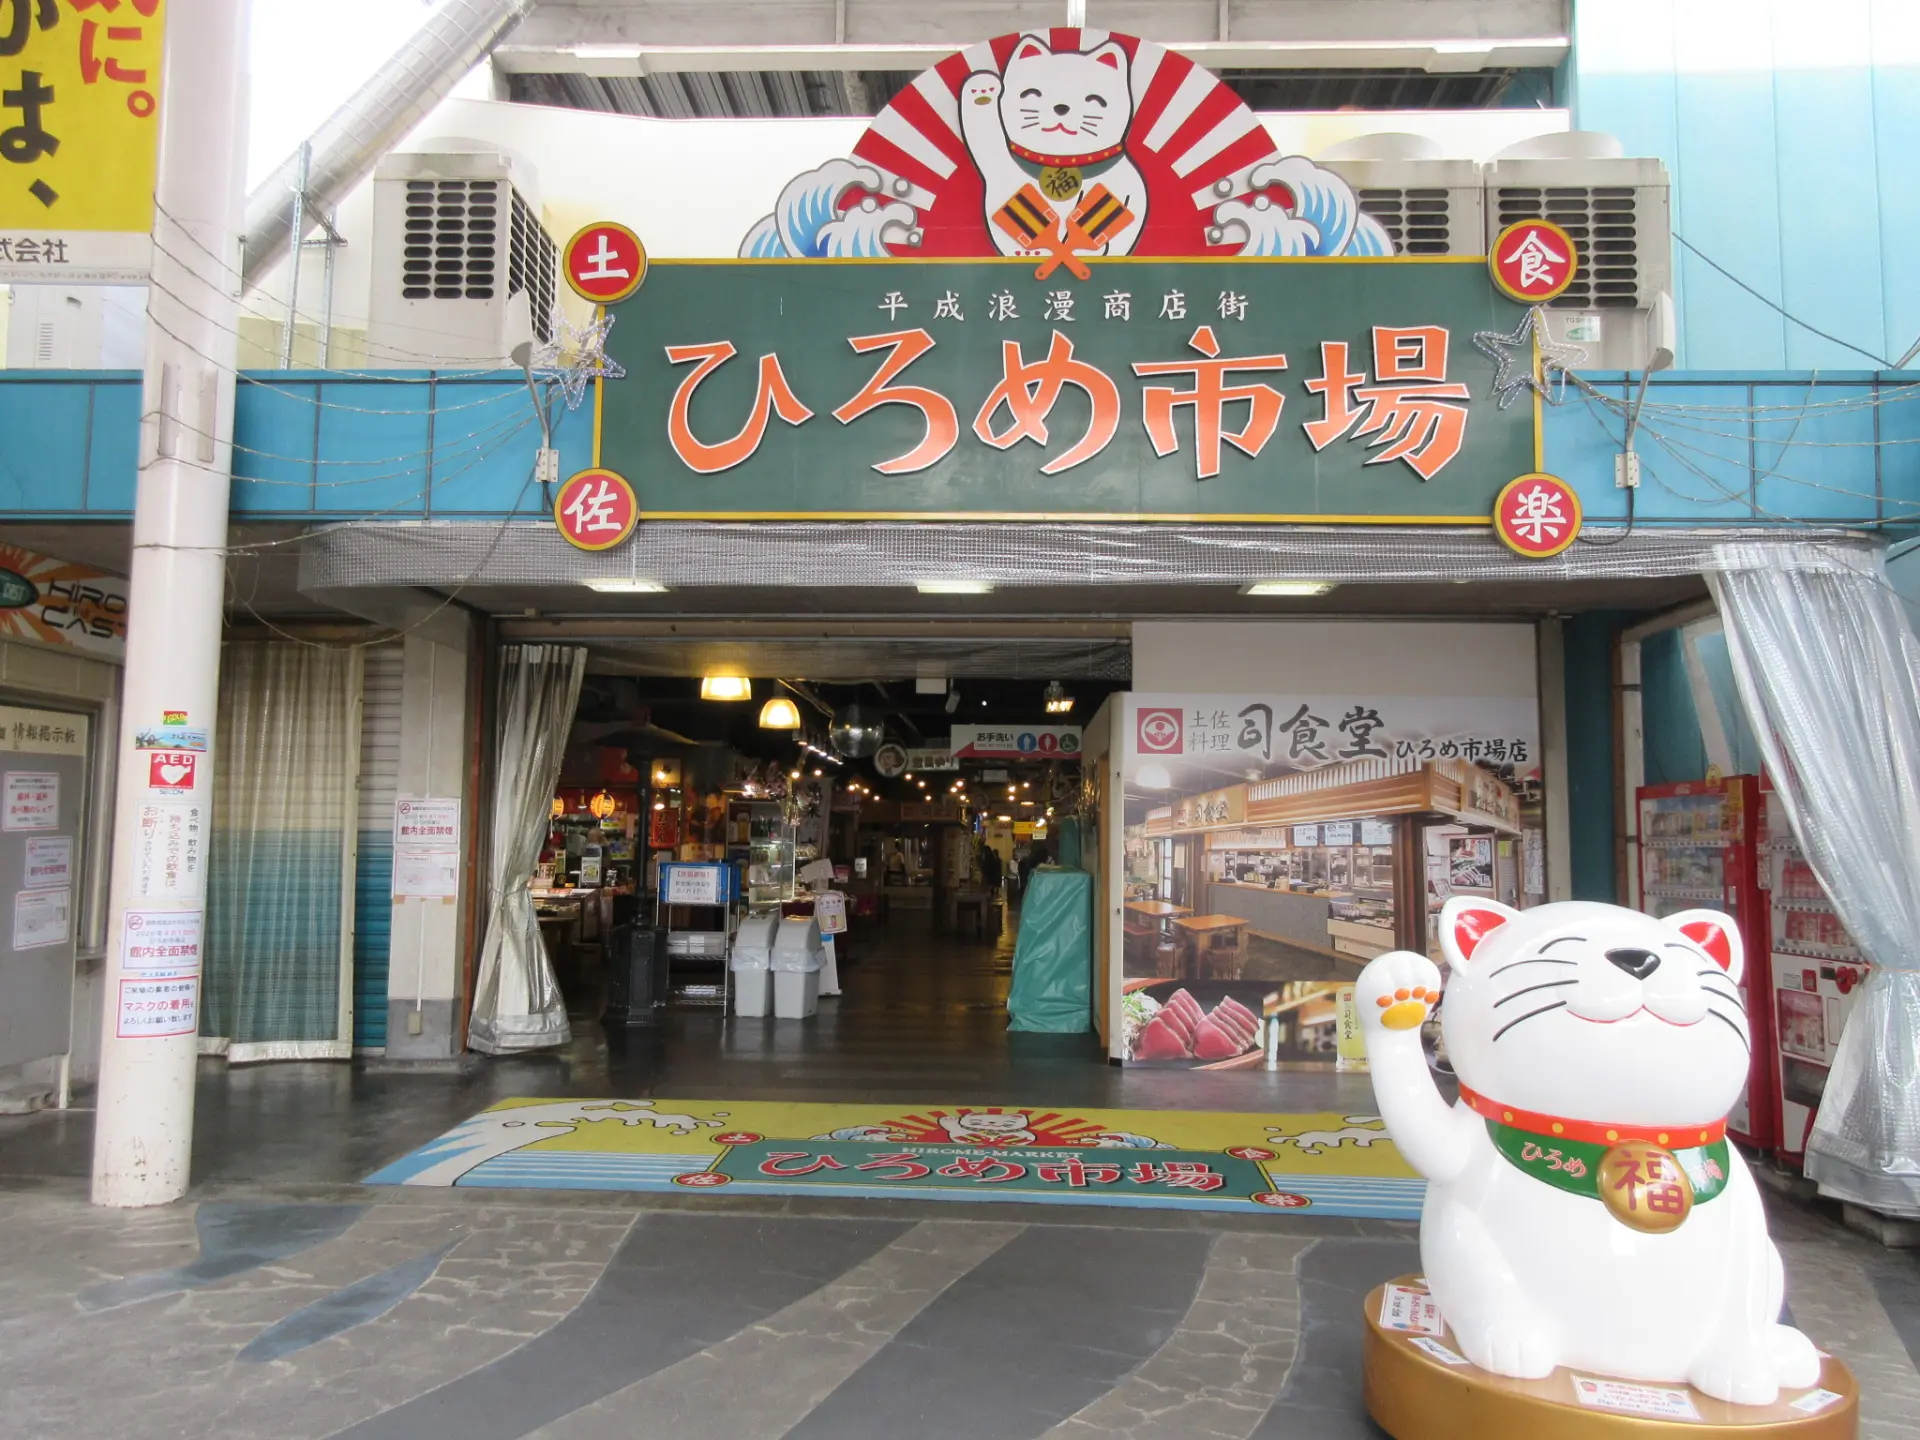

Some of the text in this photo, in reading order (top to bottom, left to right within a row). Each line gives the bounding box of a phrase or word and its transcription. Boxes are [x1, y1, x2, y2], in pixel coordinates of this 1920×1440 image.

[67, 0, 156, 118] に。
[1045, 167, 1079, 198] 福
[578, 235, 629, 280] 土
[1503, 230, 1566, 288] 食
[877, 289, 1249, 322] 平成浪漫商店街
[664, 323, 1471, 481] ひろめ市場
[563, 480, 622, 533] 佐
[1510, 485, 1567, 543] 楽
[12, 722, 76, 743] 情報掲示板
[1188, 710, 1231, 729] 土佐
[1237, 703, 1388, 761] 司食堂
[977, 732, 1014, 742] お手洗い
[1188, 731, 1231, 752] 料理
[1395, 738, 1528, 763] ひろめ市場店
[153, 754, 193, 764] AED
[130, 943, 198, 958] 館内全面禁煙
[900, 1146, 1083, 1159] HIROME-MARKET
[1521, 1142, 1588, 1178] ひろめ
[758, 1151, 1224, 1192] ひろめ市場
[1613, 1149, 1684, 1215] 福
